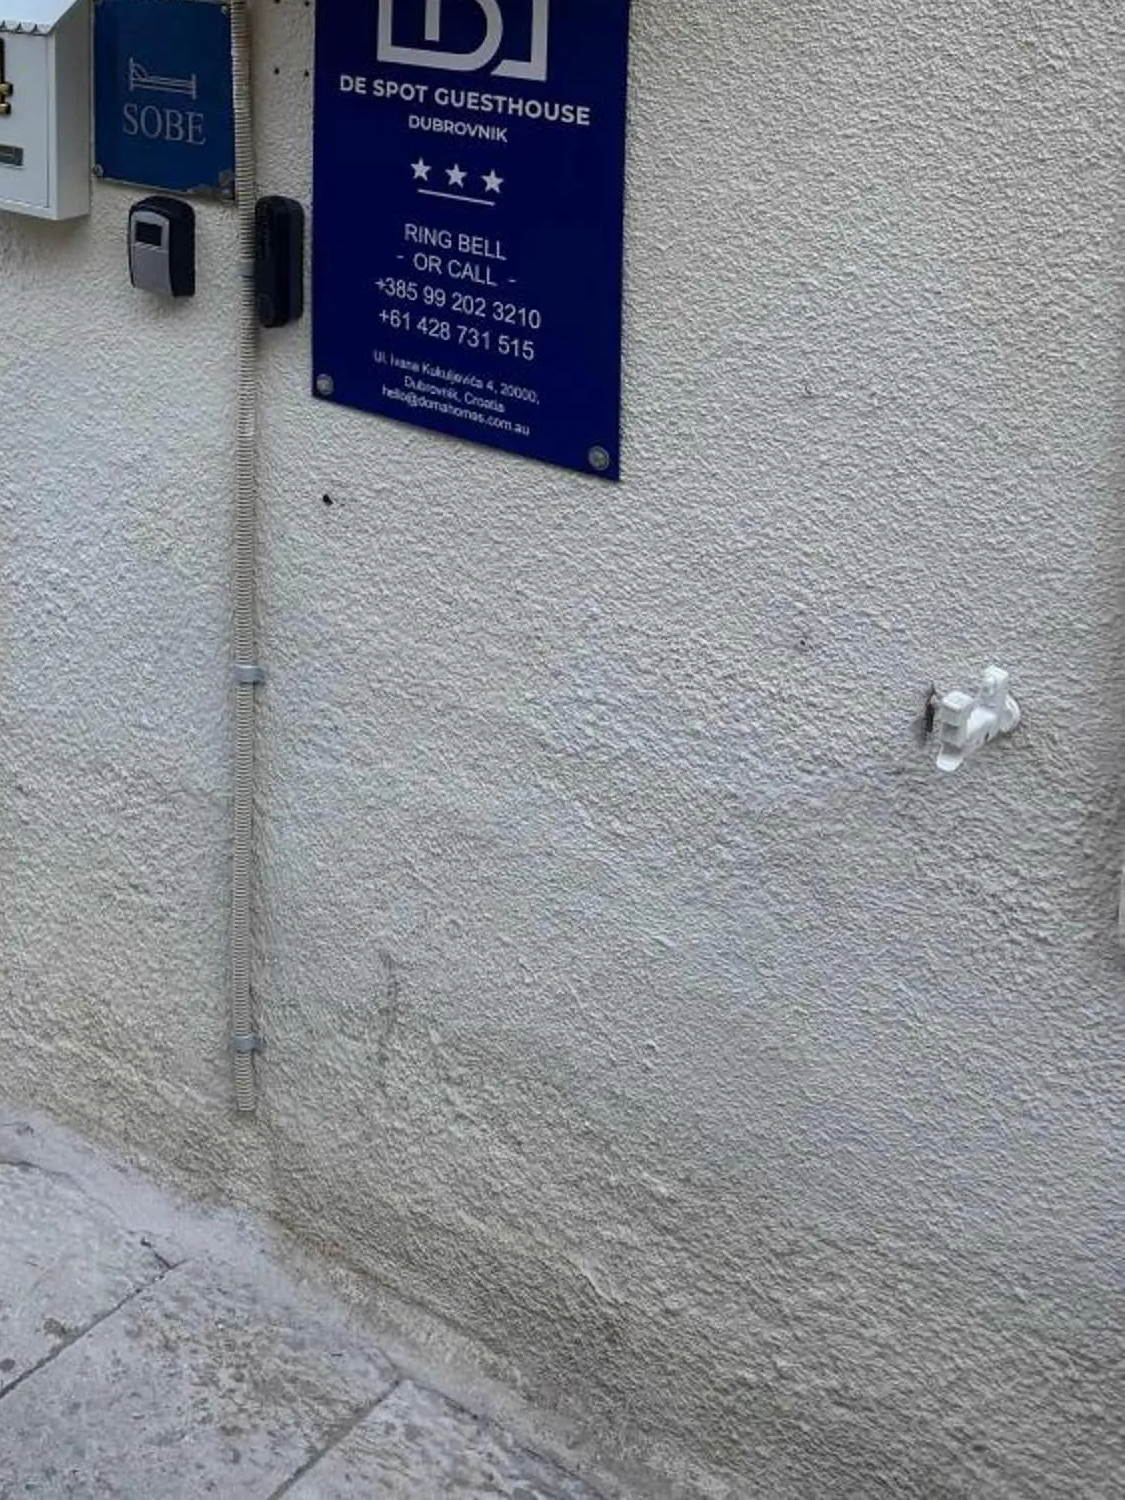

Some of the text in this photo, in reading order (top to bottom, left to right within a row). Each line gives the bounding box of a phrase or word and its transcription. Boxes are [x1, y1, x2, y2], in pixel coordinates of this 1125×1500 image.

[339, 75, 591, 126] DE SPOT GUESTHOUSE
[122, 103, 207, 145] SOBE
[408, 115, 508, 143] DUBROVNIK
[404, 223, 508, 261] RING BELL
[413, 252, 443, 275] OR
[447, 260, 498, 287] CALL
[374, 277, 542, 330] +385 99 202 3210
[379, 309, 535, 361] +61 428 731 515
